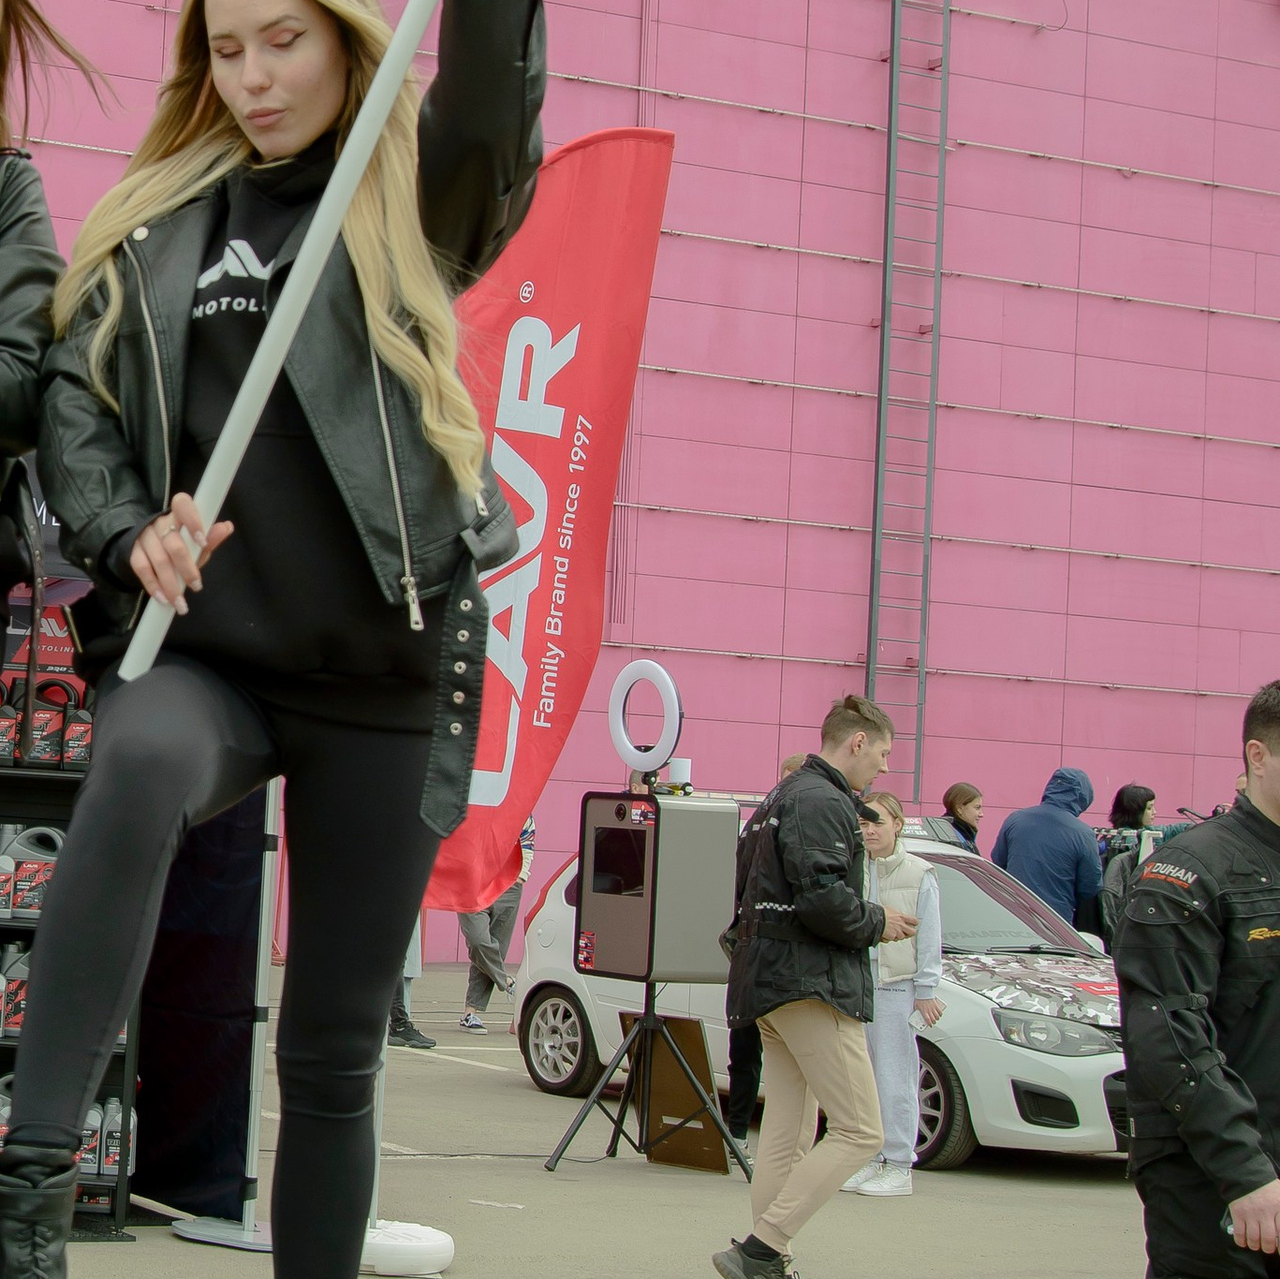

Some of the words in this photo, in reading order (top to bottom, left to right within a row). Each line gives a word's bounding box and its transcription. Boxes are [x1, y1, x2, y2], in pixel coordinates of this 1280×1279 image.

[568, 414, 594, 479] 1997
[558, 484, 583, 554] since
[6, 615, 69, 638] LAV
[544, 558, 571, 639] Brand
[532, 647, 560, 729] Family
[1152, 862, 1198, 884] DUHAN
